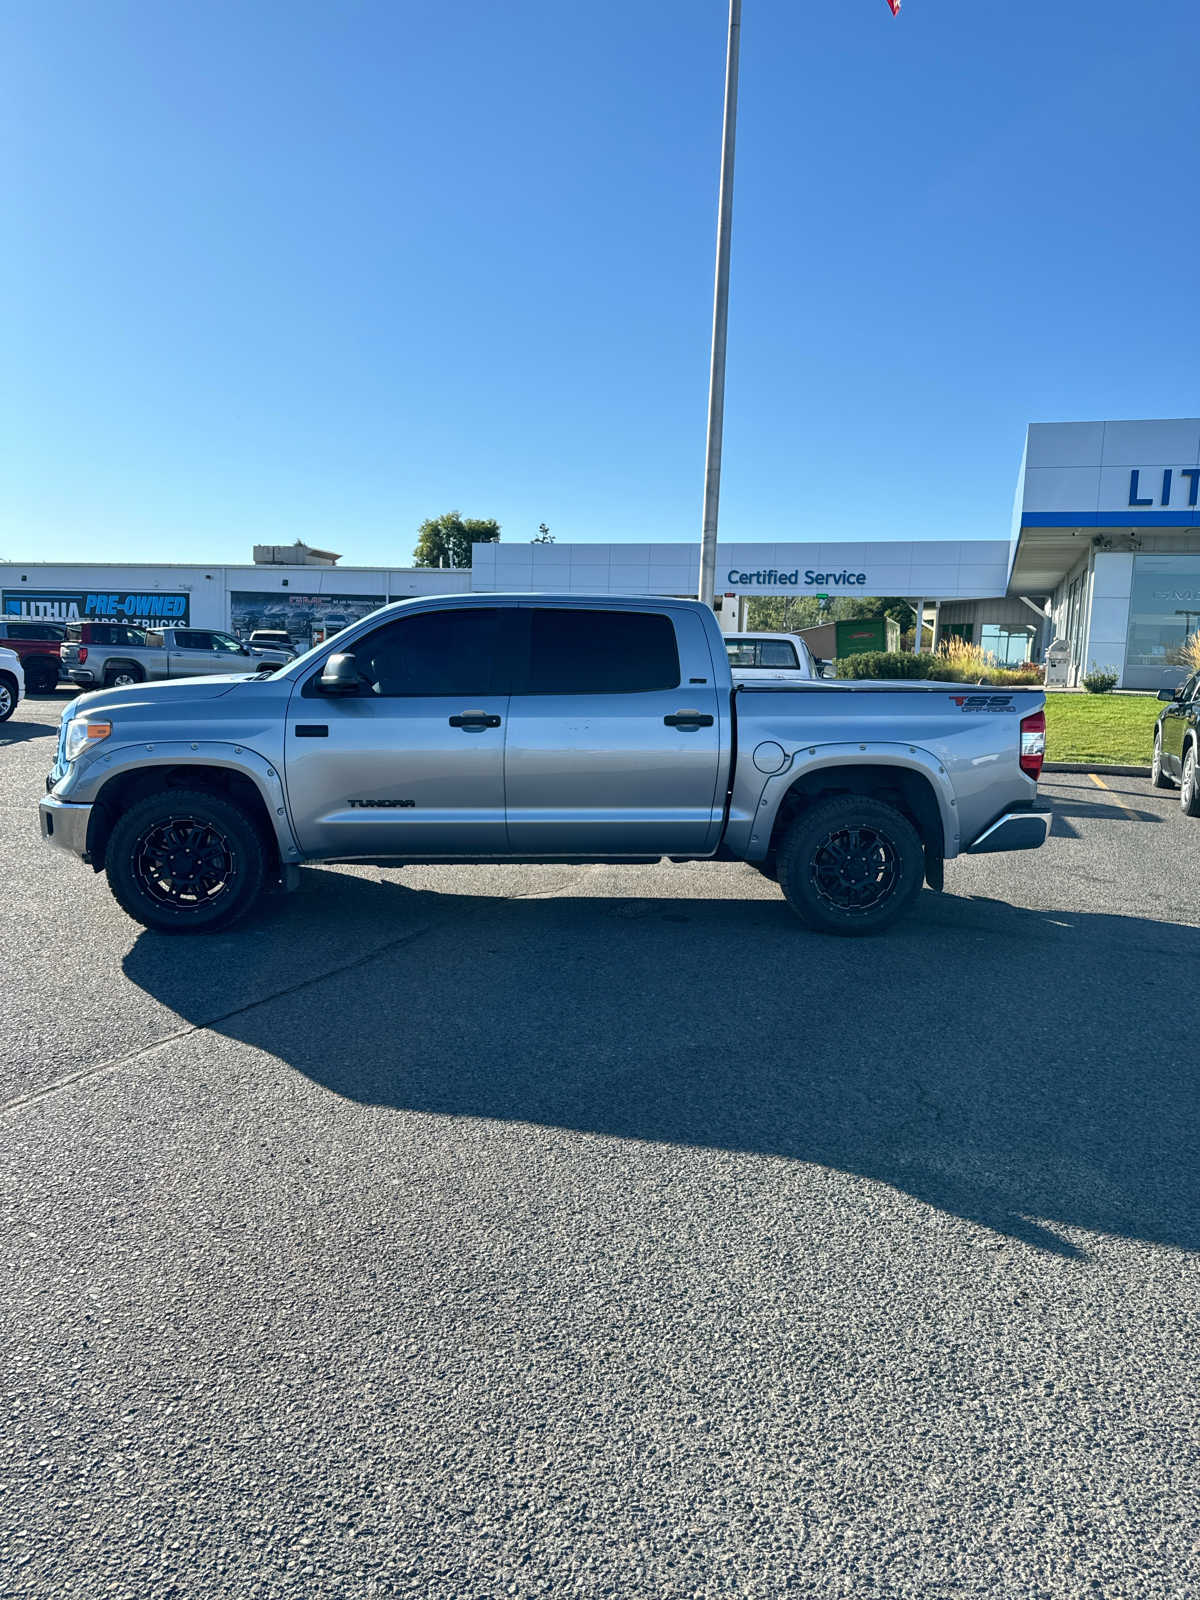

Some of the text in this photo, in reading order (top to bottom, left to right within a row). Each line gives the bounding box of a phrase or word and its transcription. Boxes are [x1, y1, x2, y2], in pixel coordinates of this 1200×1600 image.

[1128, 469, 1200, 505] LIT
[728, 570, 866, 585] Certified Service
[21, 600, 80, 620] LITHIA
[84, 594, 187, 617] PRE-OWNED
[133, 618, 187, 629] TRUCKS
[347, 799, 416, 808] TUNDRA
